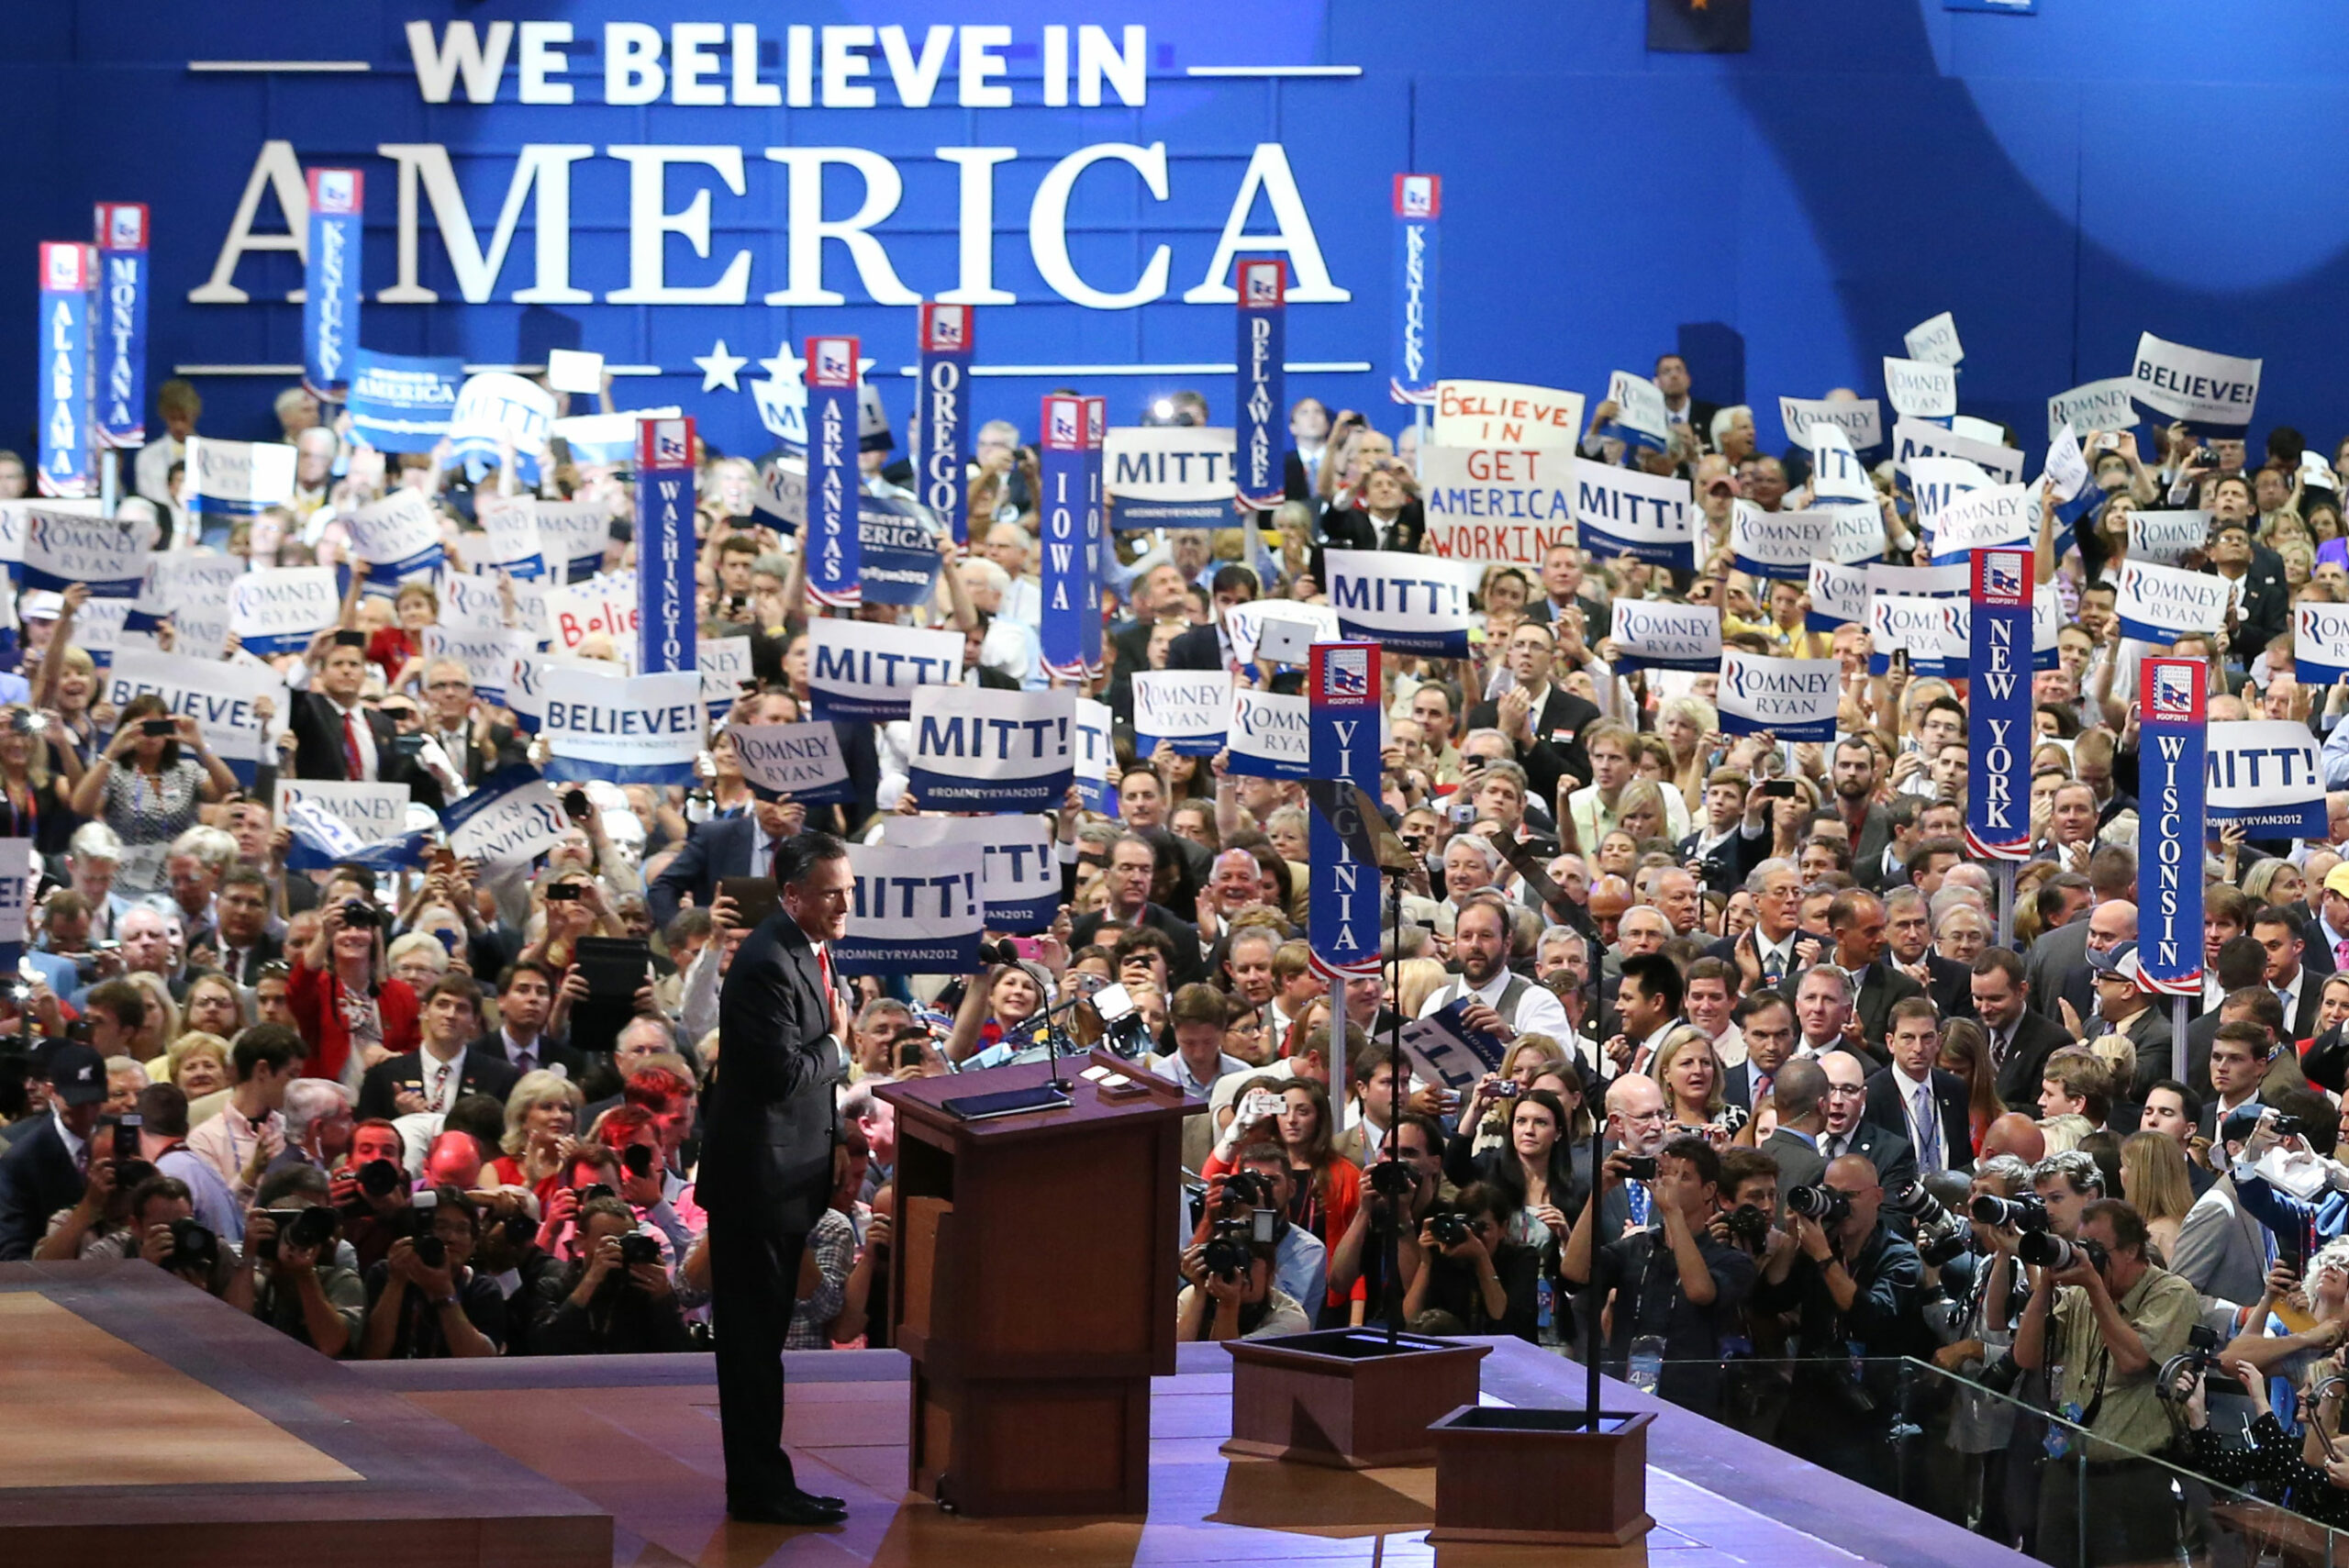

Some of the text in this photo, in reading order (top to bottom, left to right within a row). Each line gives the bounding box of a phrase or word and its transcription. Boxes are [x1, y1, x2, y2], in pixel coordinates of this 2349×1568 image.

[406, 20, 1146, 108] WE BELIEVE IN
[187, 140, 1352, 310] AMERICA
[109, 258, 138, 426] MONTANA
[50, 299, 76, 475] ALABAMA
[2137, 360, 2254, 405] BELIEVE!
[1247, 317, 1274, 488] DELAWARE
[1441, 386, 1569, 428] BELIEVE
[1482, 421, 1524, 443] IN
[1467, 450, 1541, 482] GET
[822, 397, 844, 582] ARKANSAS
[1428, 487, 1570, 520] AMERICA
[1579, 480, 1685, 530] MITT!
[858, 522, 935, 550] ERICA
[1049, 472, 1074, 611] IOWA
[1736, 507, 1827, 542] ROMNEY
[2133, 517, 2202, 550] ROMNEY
[1757, 543, 1811, 558] RYAN
[233, 580, 328, 617] ROMNEY
[1333, 574, 1461, 616] MITT!
[1815, 567, 1866, 601] ROM
[2125, 567, 2222, 608] ROMNEY
[560, 603, 638, 648] Belie
[1618, 606, 1713, 641] ROMNEY
[1842, 600, 1865, 615] RY
[2150, 603, 2205, 626] RYAN
[1645, 639, 1703, 653] RYAN
[1905, 634, 1943, 651] RYA
[1983, 618, 2019, 701] NEW
[699, 651, 744, 673] NEY
[816, 645, 952, 687] MITT!
[1726, 660, 1834, 699] ROMNEY
[1137, 679, 1224, 716] ROMNEY
[1237, 697, 1310, 735] ROMN
[1755, 697, 1817, 715] RYAN
[548, 702, 697, 735] BELIEVE!
[1156, 711, 1210, 727] RYAN
[729, 731, 829, 769] ROMNEY
[918, 716, 1068, 760] MITT!
[1264, 735, 1307, 753] RYA
[764, 763, 825, 783] RYAN
[1985, 718, 2013, 829] YORK
[928, 785, 1050, 799] #ROMNEYRYAN2012
[1331, 720, 1359, 951] VIRGINIA
[2156, 735, 2187, 968] WISCONSIN
